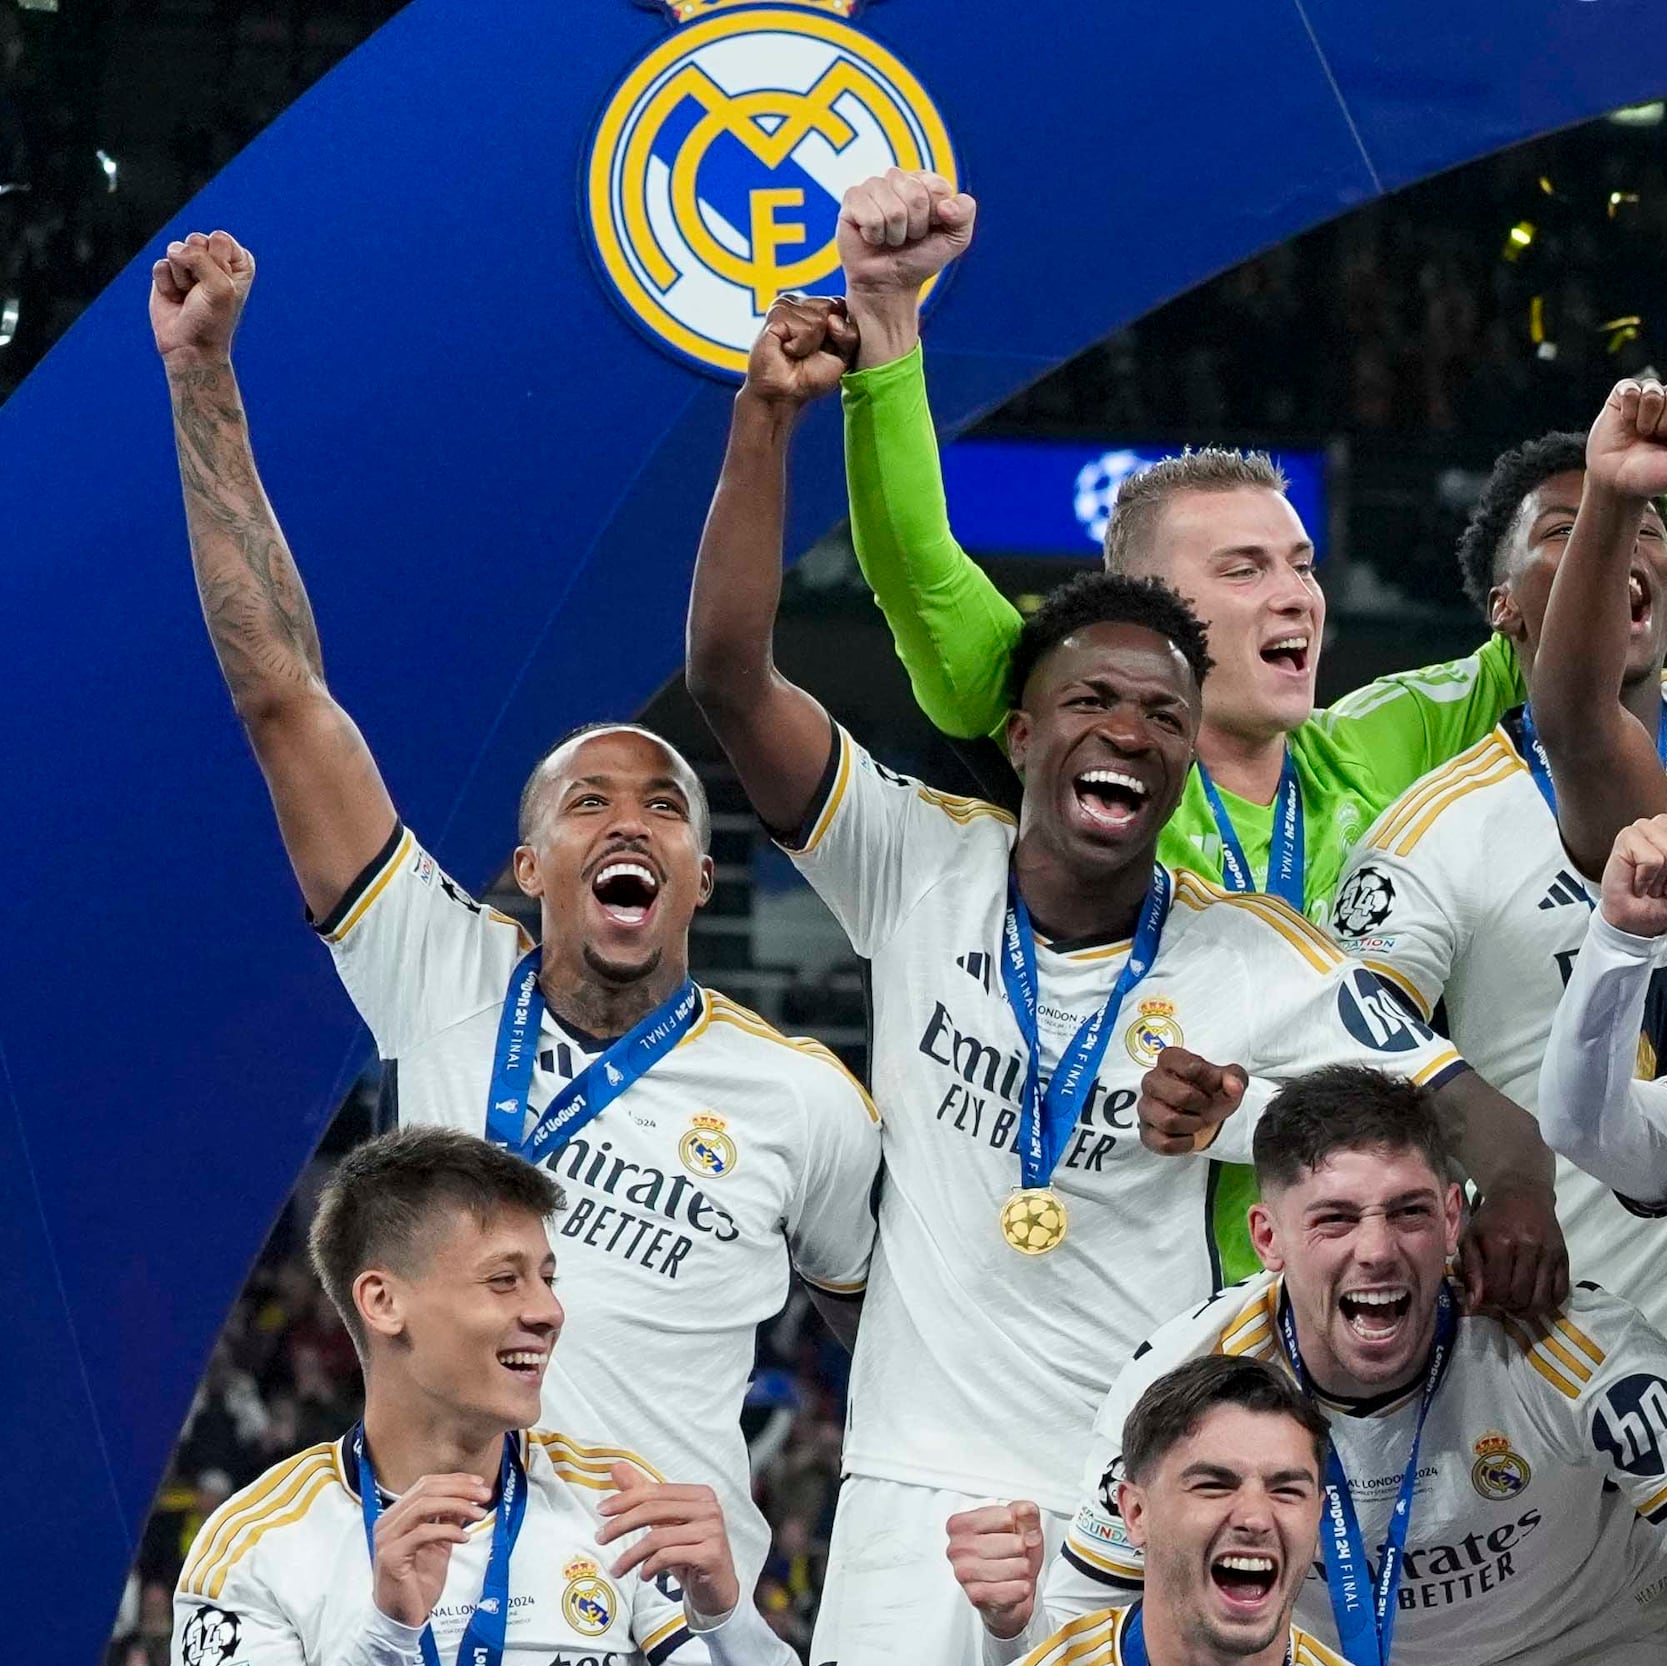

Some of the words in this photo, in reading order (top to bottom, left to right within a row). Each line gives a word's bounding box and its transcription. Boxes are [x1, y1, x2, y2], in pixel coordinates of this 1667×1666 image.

[515, 1009, 527, 1025] 24
[1037, 1005, 1076, 1022] ONDON
[1339, 969, 1433, 1052] hp
[507, 1029, 524, 1070] FINAL
[1082, 1033, 1097, 1049] 24
[1062, 1052, 1088, 1096] FINAL
[938, 1083, 982, 1137] FLY
[546, 1137, 739, 1243] mirates
[566, 1196, 691, 1281] BETTER
[1336, 1540, 1350, 1558] 24
[1403, 1508, 1543, 1580] rates
[1341, 1565, 1358, 1612] FINAL
[1400, 1553, 1514, 1611] BETTER
[191, 1623, 226, 1657] 14
